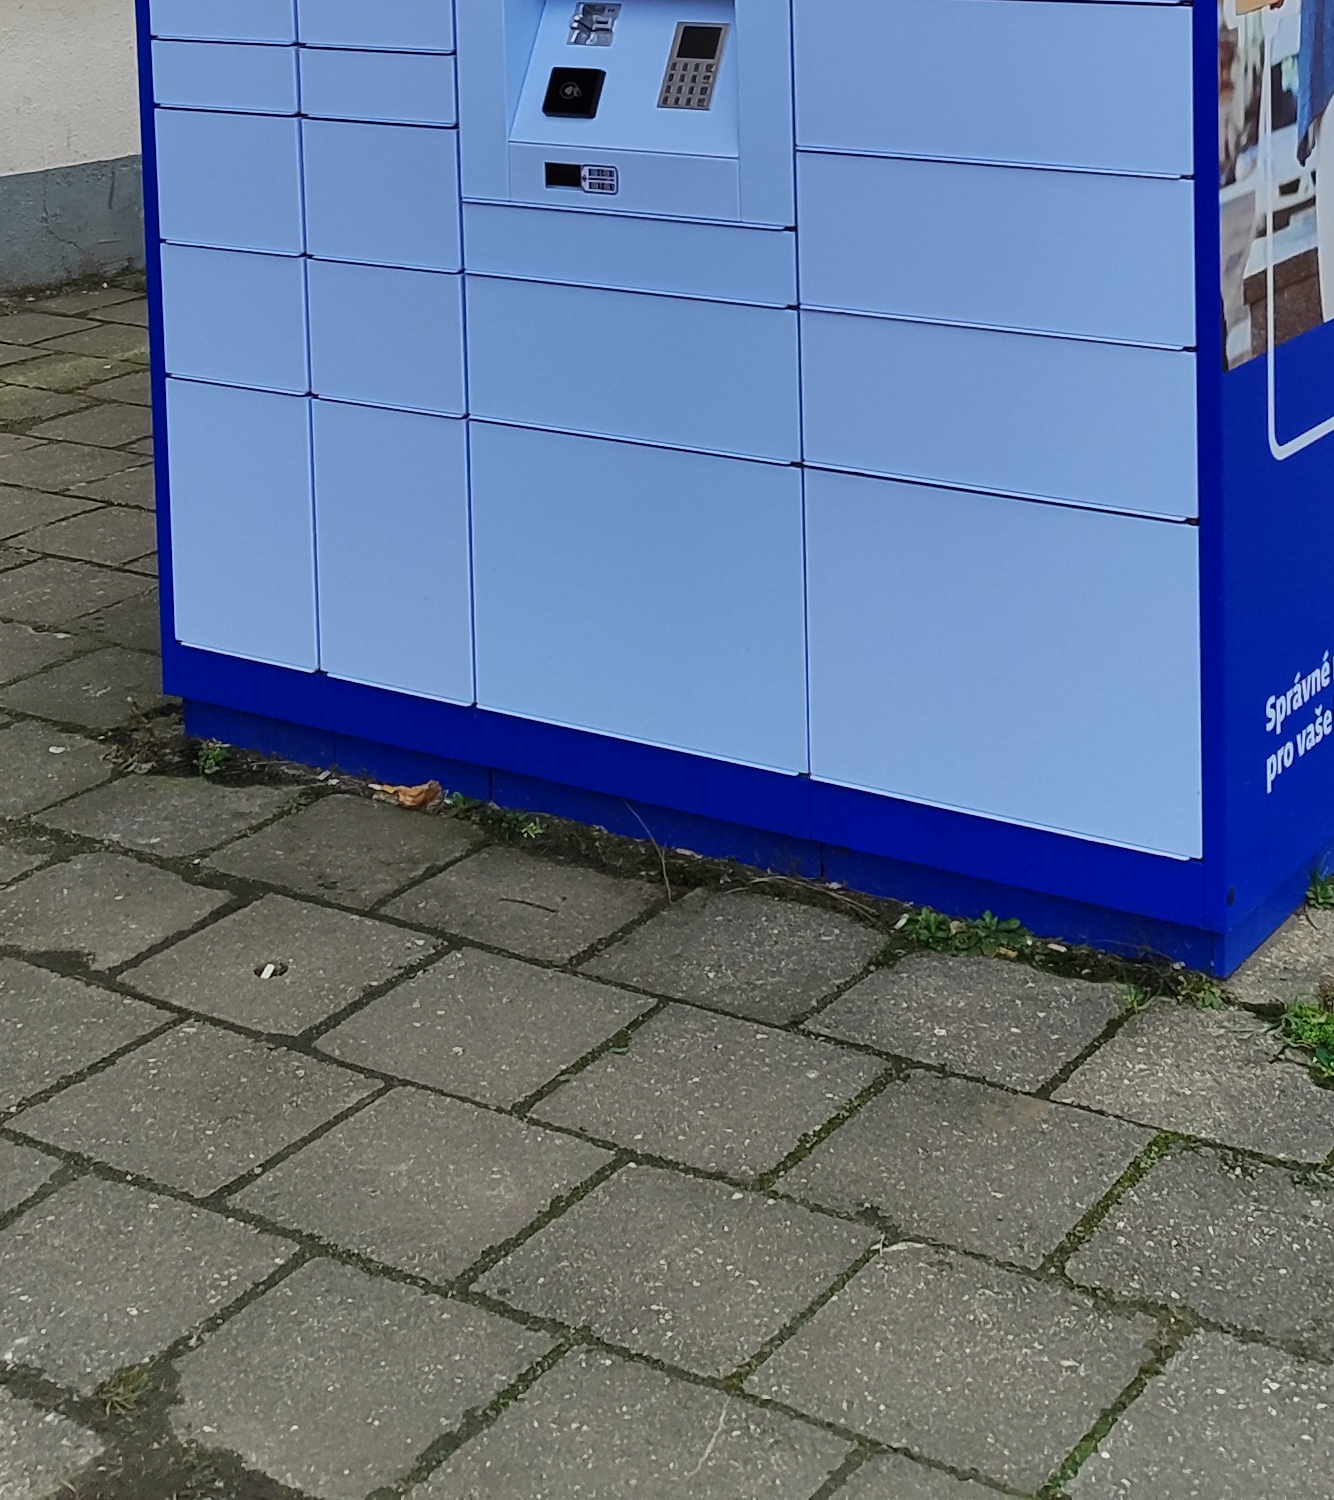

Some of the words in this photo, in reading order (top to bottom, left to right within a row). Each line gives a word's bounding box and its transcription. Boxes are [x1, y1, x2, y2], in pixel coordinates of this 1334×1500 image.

[1265, 649, 1331, 735] Správné
[1266, 740, 1295, 794] pro
[1295, 704, 1333, 757] vaše
